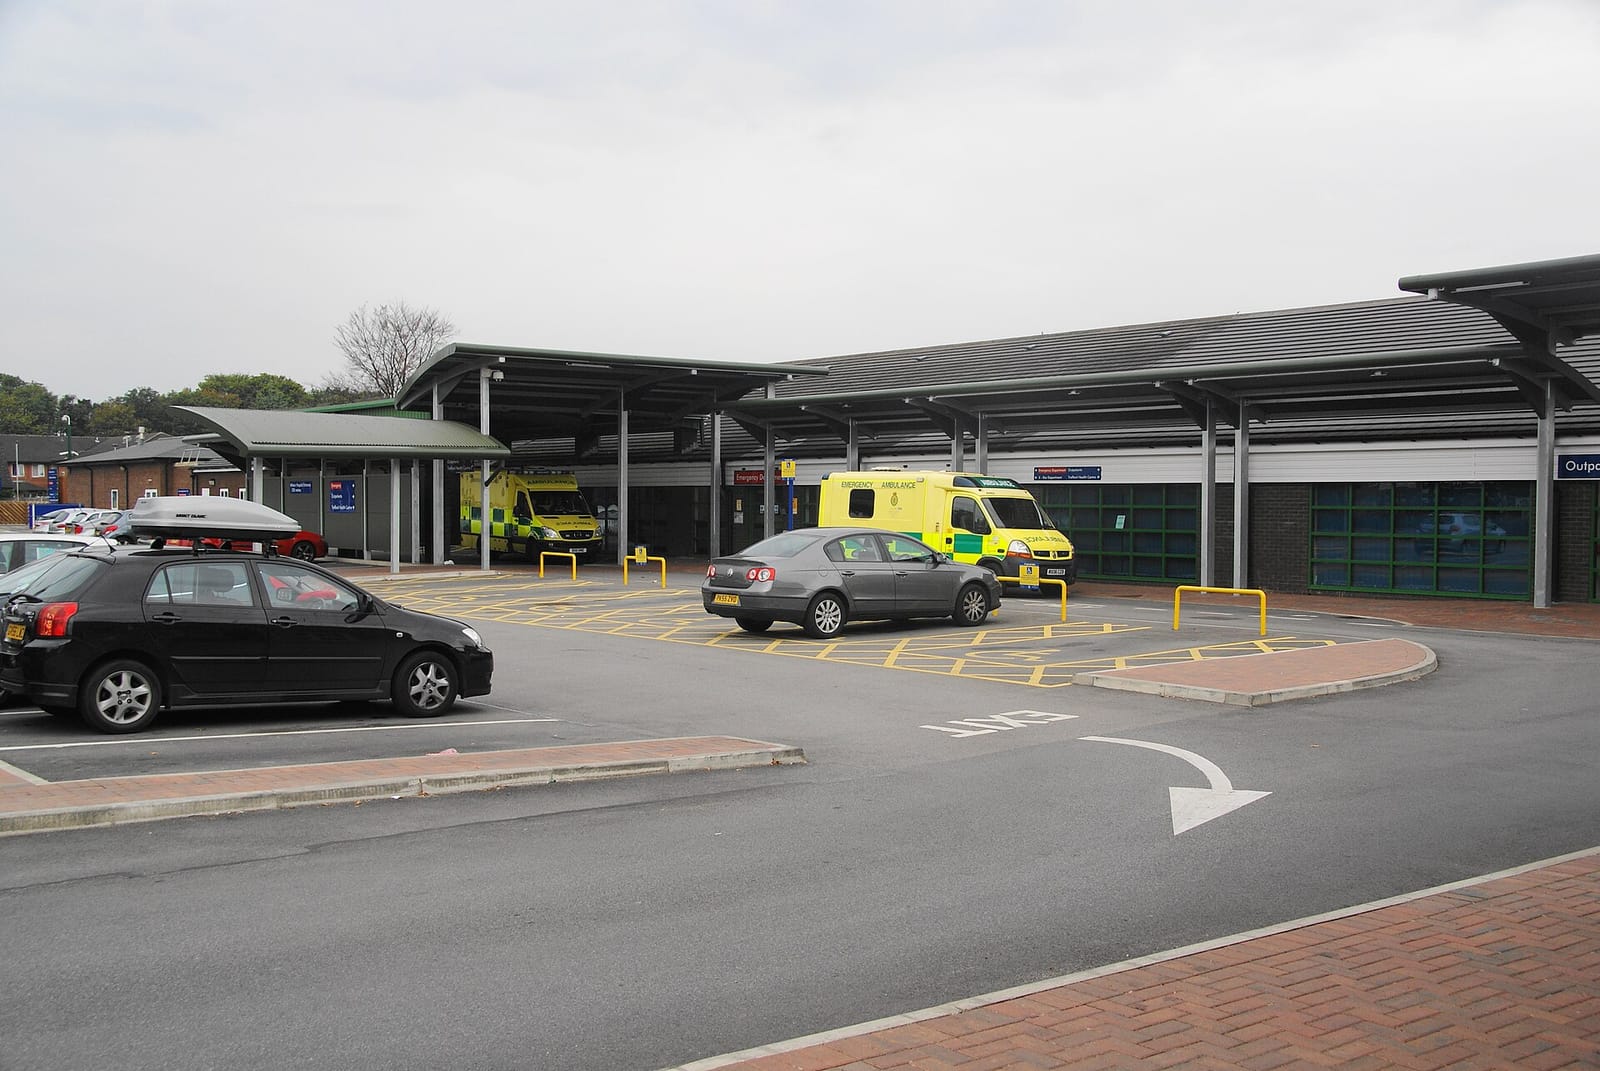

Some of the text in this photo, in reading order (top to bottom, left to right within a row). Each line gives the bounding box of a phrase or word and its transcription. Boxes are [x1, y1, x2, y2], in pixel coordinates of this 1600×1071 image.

[736, 473, 758, 482] Emergency
[841, 481, 916, 489] EMERGENCY AMBULANCE
[919, 709, 1080, 738] EXIT
